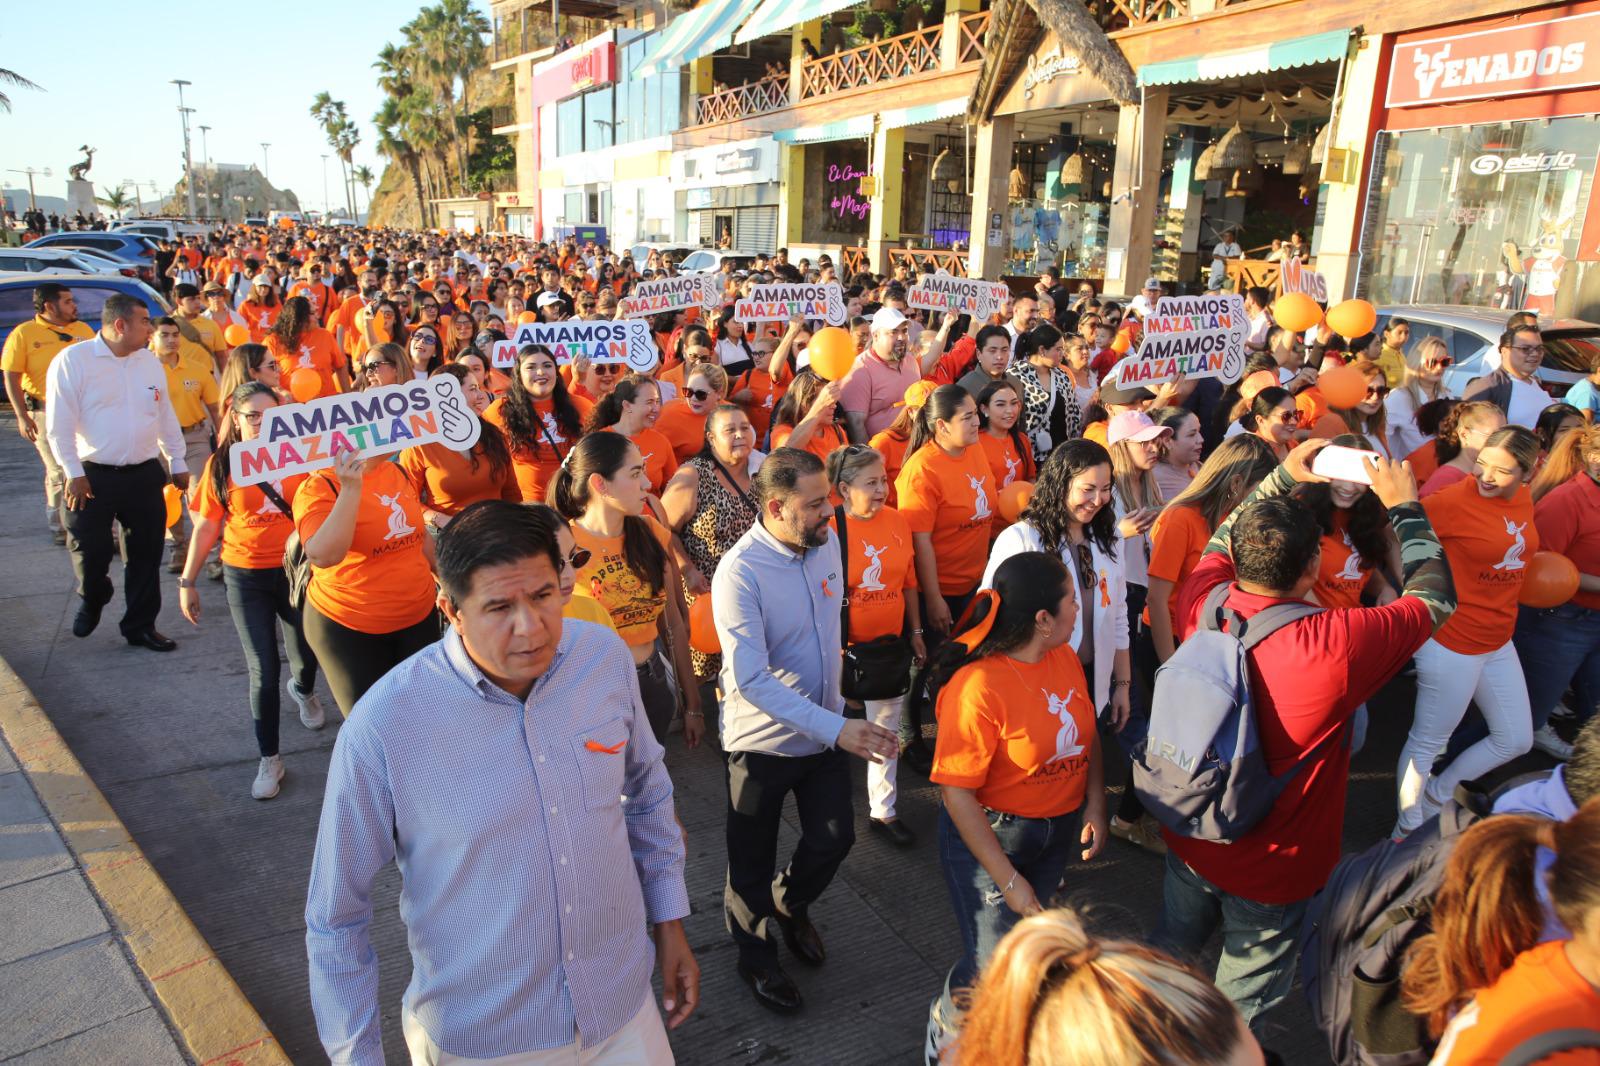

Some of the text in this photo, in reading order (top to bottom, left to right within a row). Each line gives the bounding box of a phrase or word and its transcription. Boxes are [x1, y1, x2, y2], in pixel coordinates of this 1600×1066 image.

[1414, 43, 1586, 98] VENADOS
[638, 277, 702, 299] AMAMOS
[753, 287, 826, 302] AMAMOS
[923, 278, 978, 297] AMAMOS
[1159, 299, 1229, 316] AMAMOS
[518, 325, 627, 344] AMAMOS
[497, 341, 627, 362] MATLÁN
[1141, 334, 1227, 361] AMAMOS
[268, 387, 431, 443] AMAMOS
[1033, 755, 1089, 778] MAZATLA
